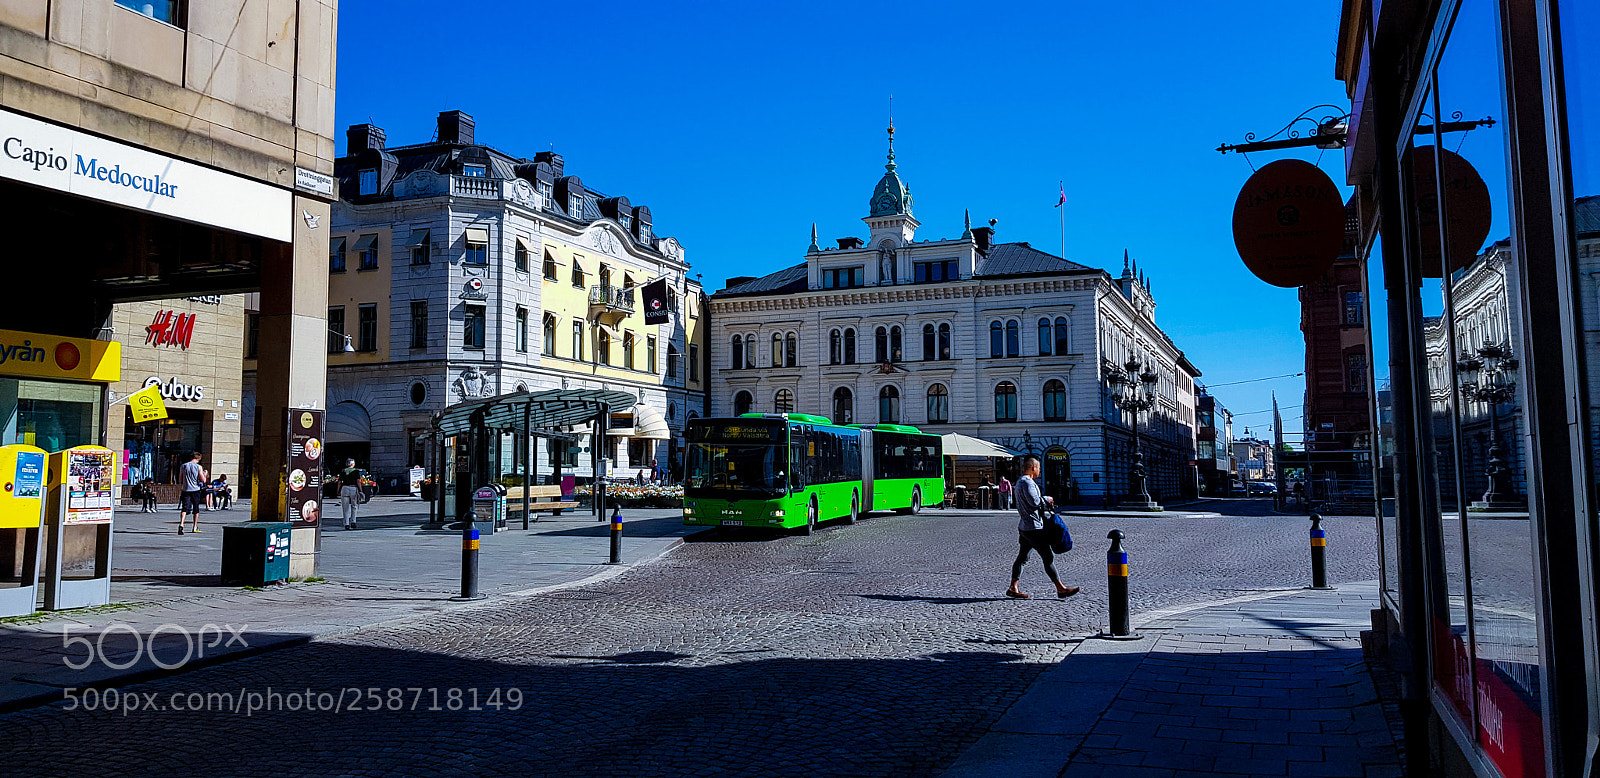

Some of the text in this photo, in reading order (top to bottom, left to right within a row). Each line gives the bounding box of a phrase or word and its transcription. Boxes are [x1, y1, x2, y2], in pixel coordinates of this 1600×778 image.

[3, 137, 179, 199] Capio Medocular
[1246, 185, 1330, 208] JAMESON
[147, 309, 196, 349] H&M
[145, 376, 204, 400] Cubus
[704, 427, 711, 438] 7
